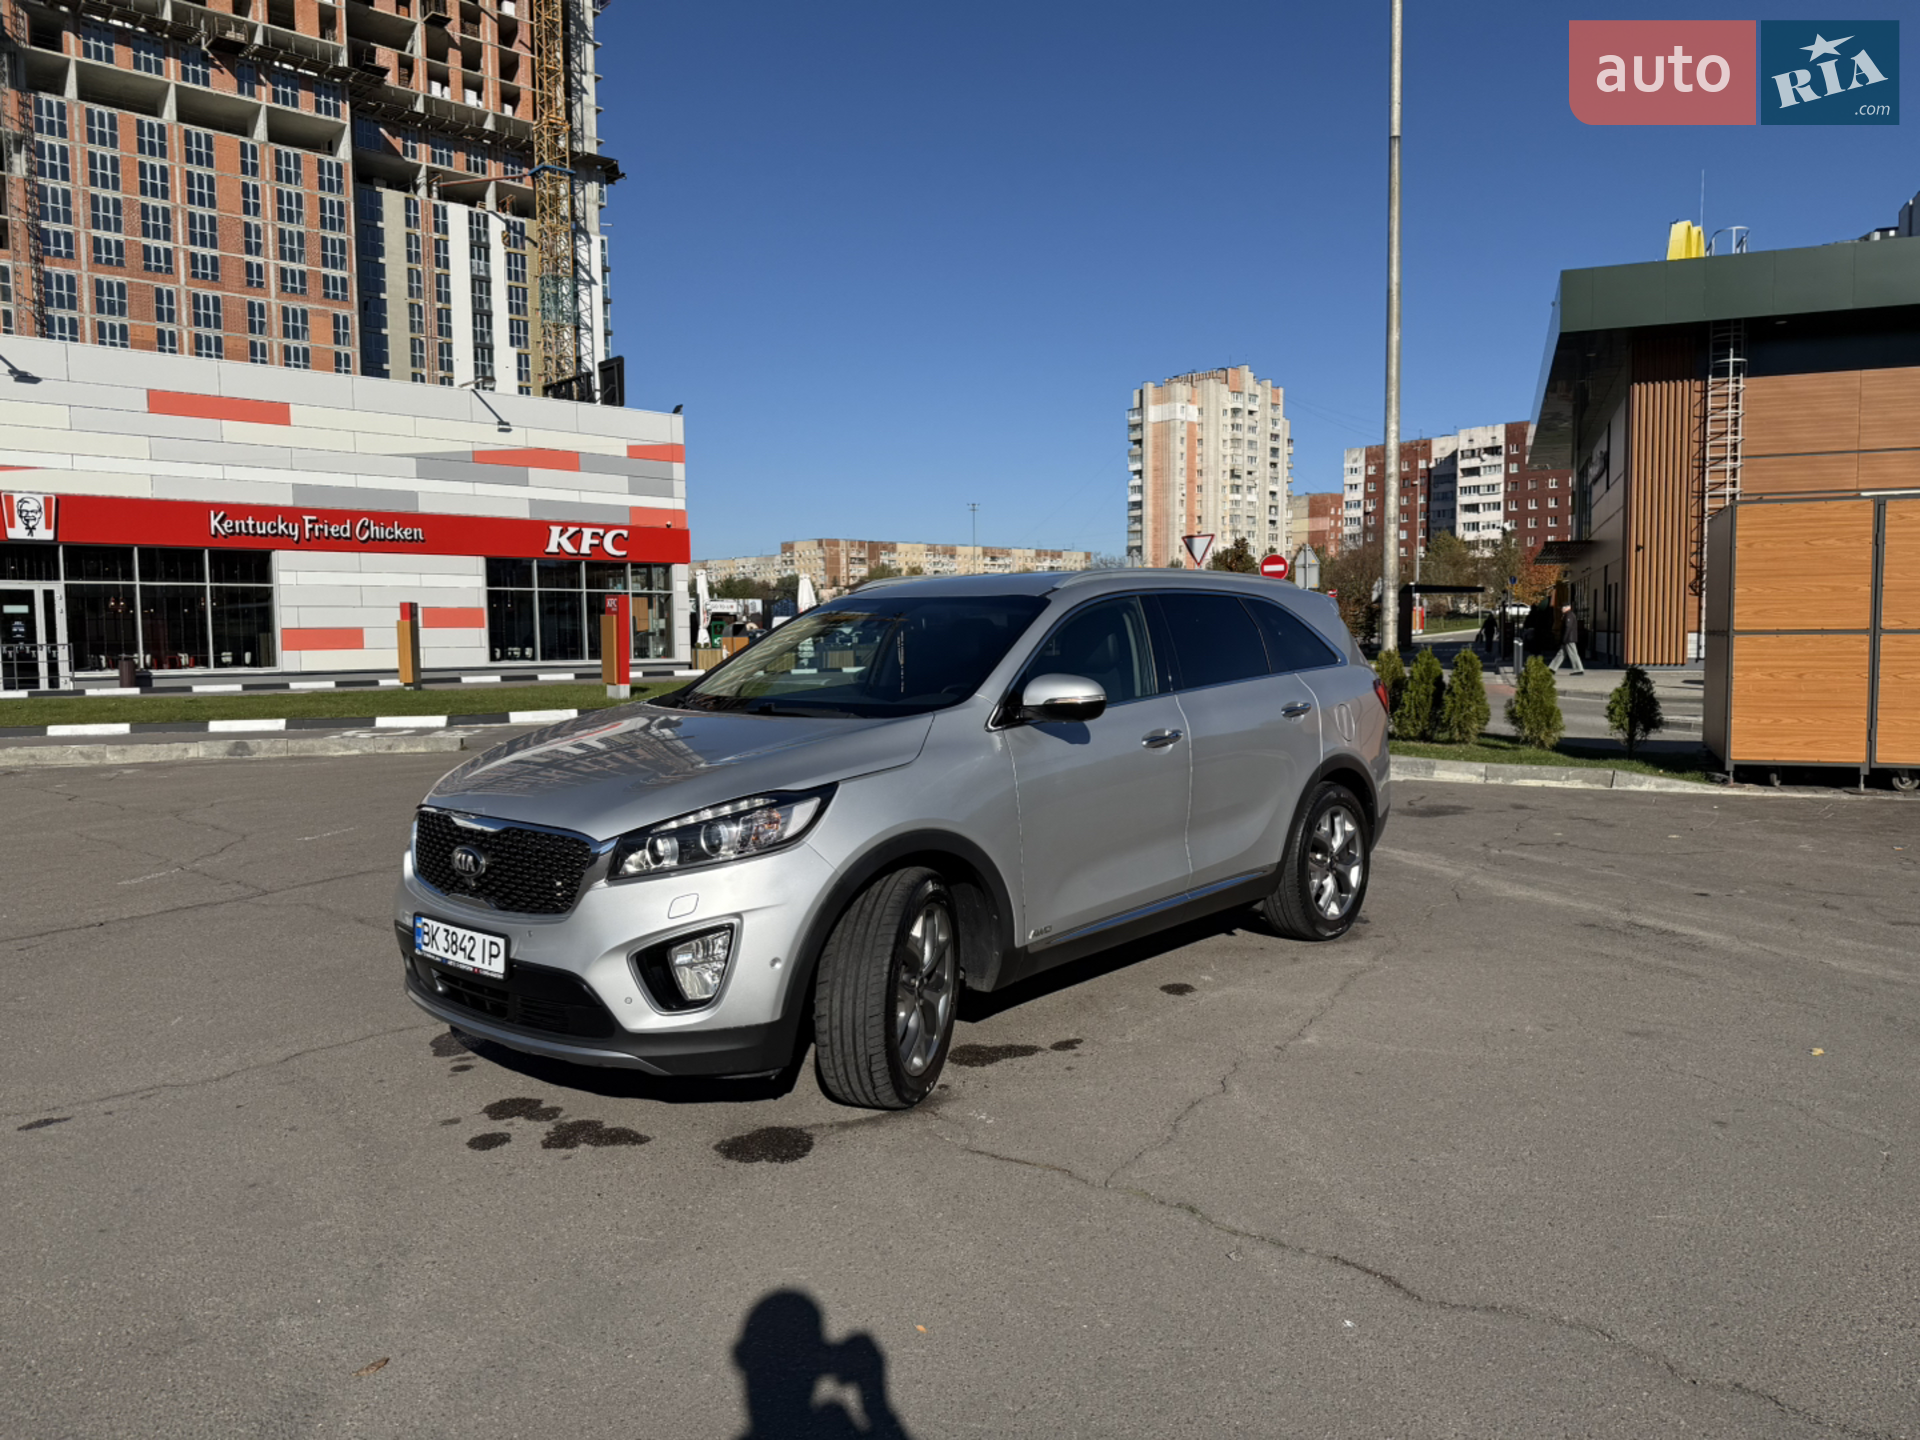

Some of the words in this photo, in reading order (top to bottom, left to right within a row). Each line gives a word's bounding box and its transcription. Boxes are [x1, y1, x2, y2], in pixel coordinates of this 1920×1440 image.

[210, 510, 299, 542] Kentucky
[302, 515, 351, 540] Fried
[355, 517, 425, 542] Chicken
[544, 525, 629, 557] KFC
[455, 852, 475, 872] KIA
[423, 922, 440, 951] BK
[443, 928, 476, 962] 3842
[481, 938, 501, 966] IP
